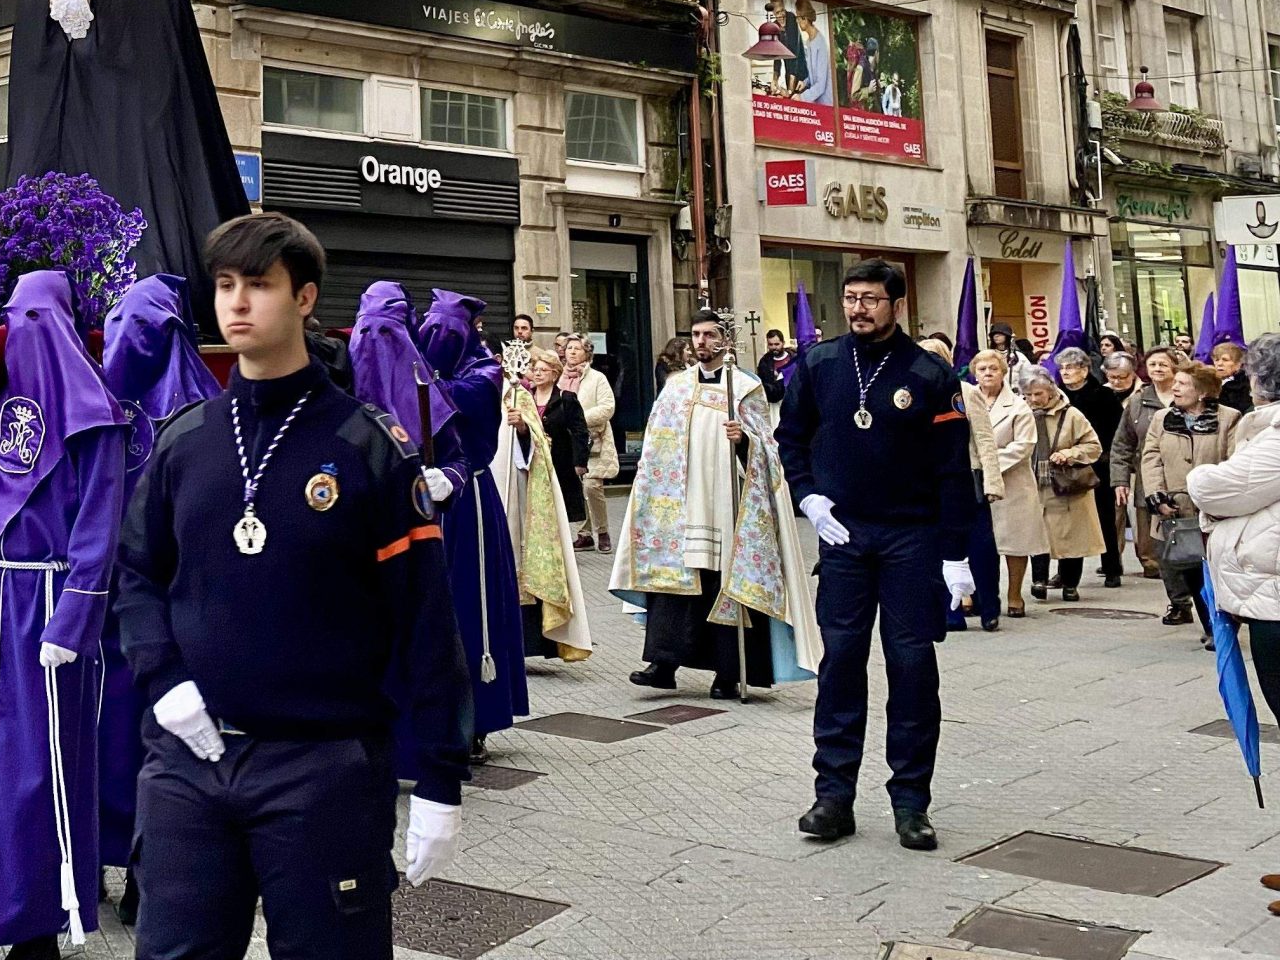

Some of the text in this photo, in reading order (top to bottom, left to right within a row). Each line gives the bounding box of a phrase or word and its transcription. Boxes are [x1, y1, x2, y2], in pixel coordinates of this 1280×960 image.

[422, 4, 555, 42] VIAJES El Corte Inglés
[815, 130, 834, 143] GAES
[904, 142, 921, 154] GAES
[361, 156, 442, 194] Orange
[768, 174, 804, 188] GAES
[823, 181, 888, 223] GAES
[904, 212, 941, 229] amplifon
